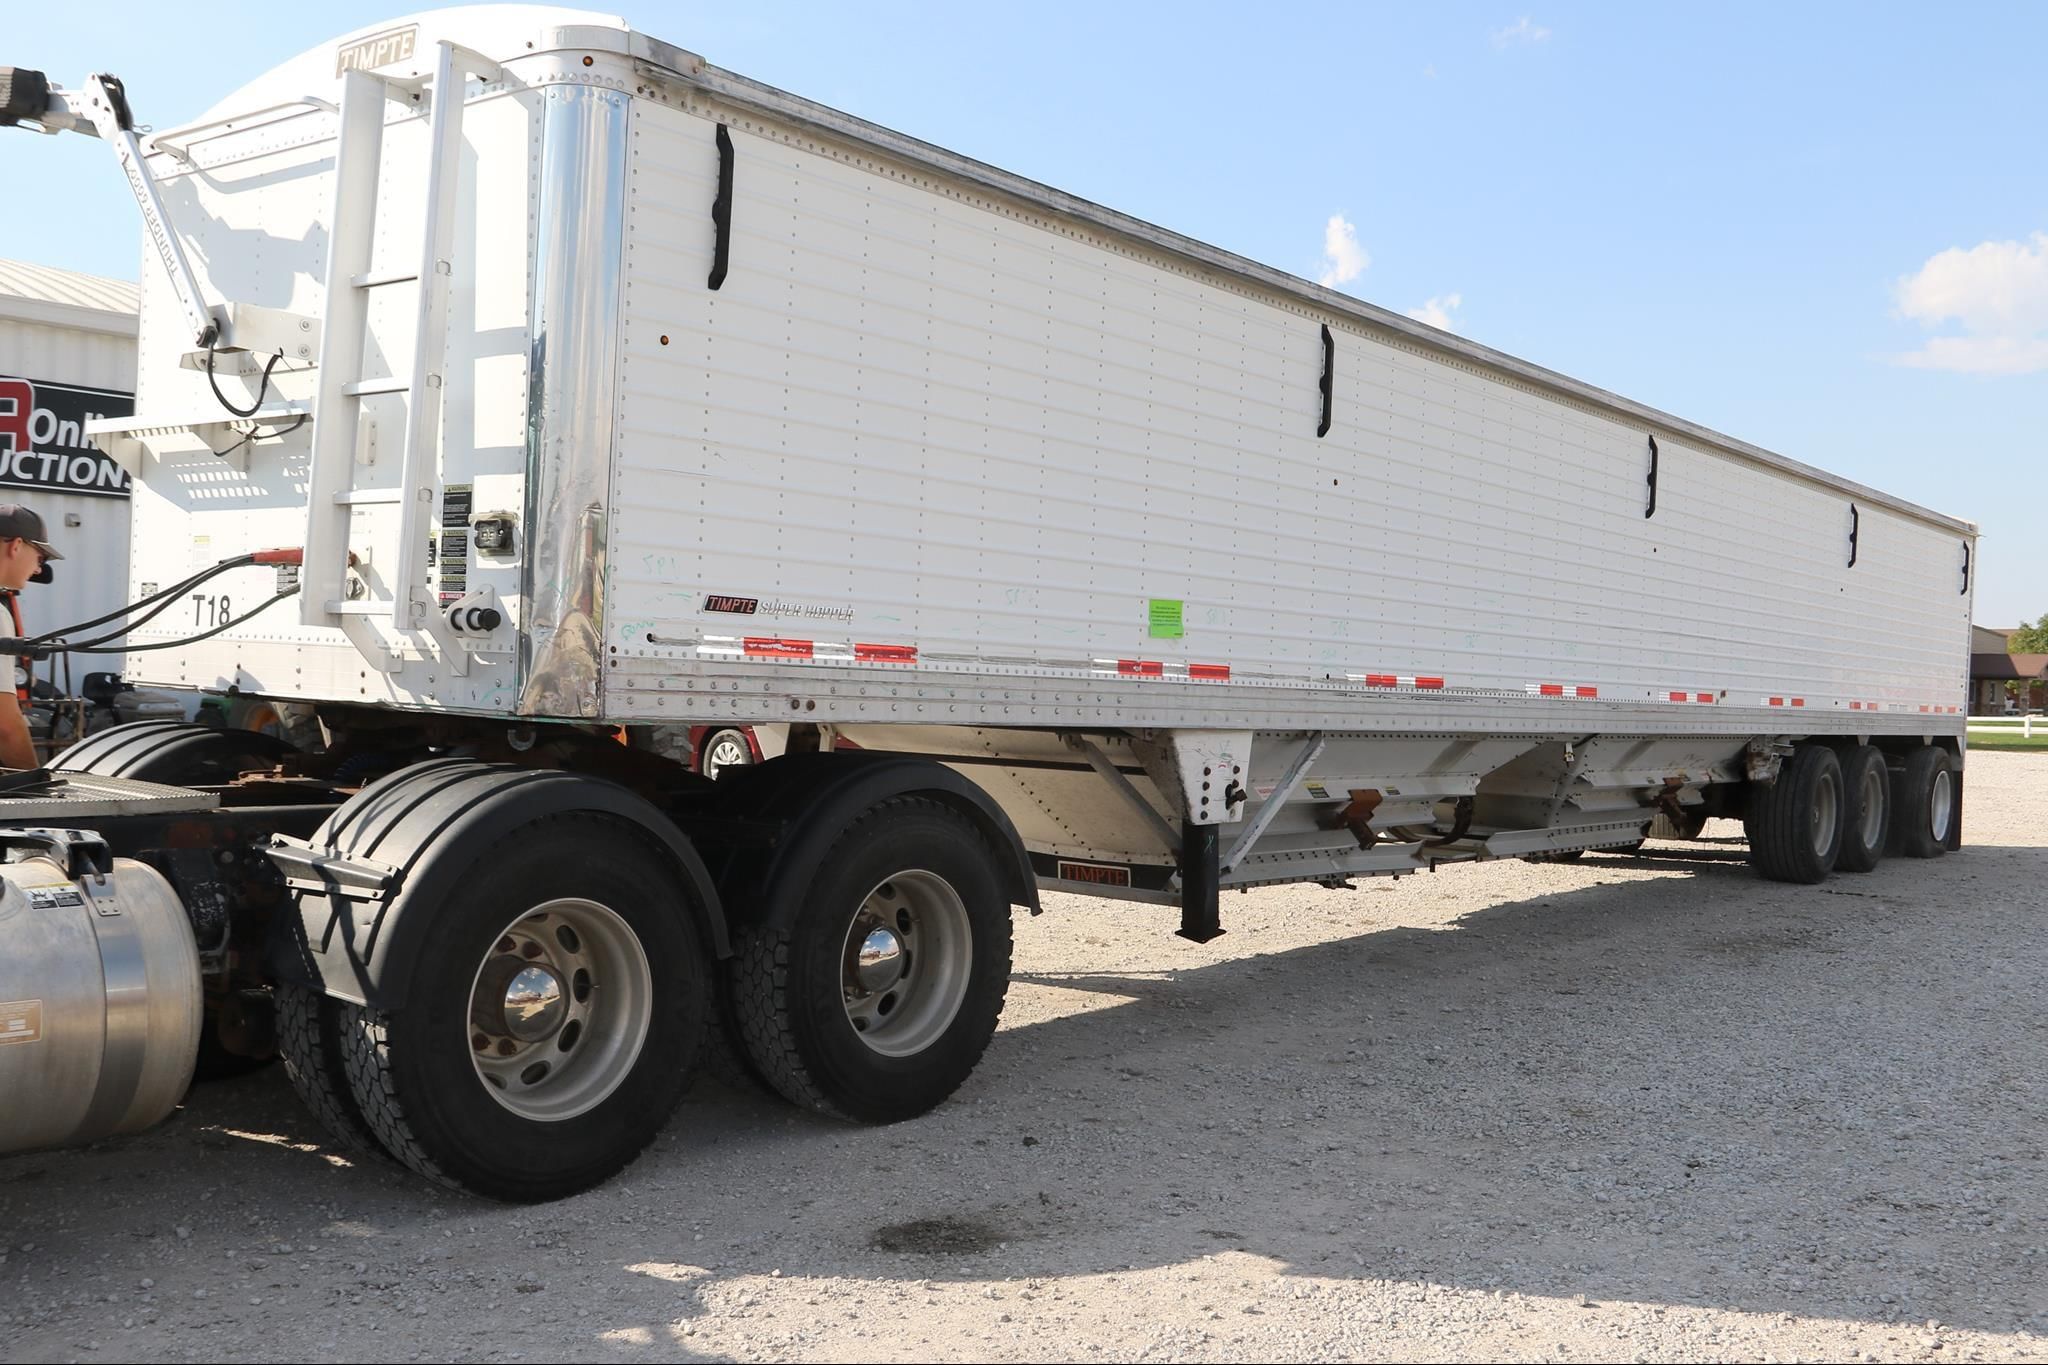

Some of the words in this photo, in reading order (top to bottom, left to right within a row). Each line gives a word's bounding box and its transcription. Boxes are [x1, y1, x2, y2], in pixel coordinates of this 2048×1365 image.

[340, 31, 415, 71] TIMPTE
[146, 206, 179, 277] THUNDER
[192, 594, 231, 627] T18
[708, 596, 757, 613] TIMPTE
[759, 601, 803, 616] SUPER
[805, 604, 856, 621] HOPPER
[1063, 864, 1125, 887] TIMPTE
